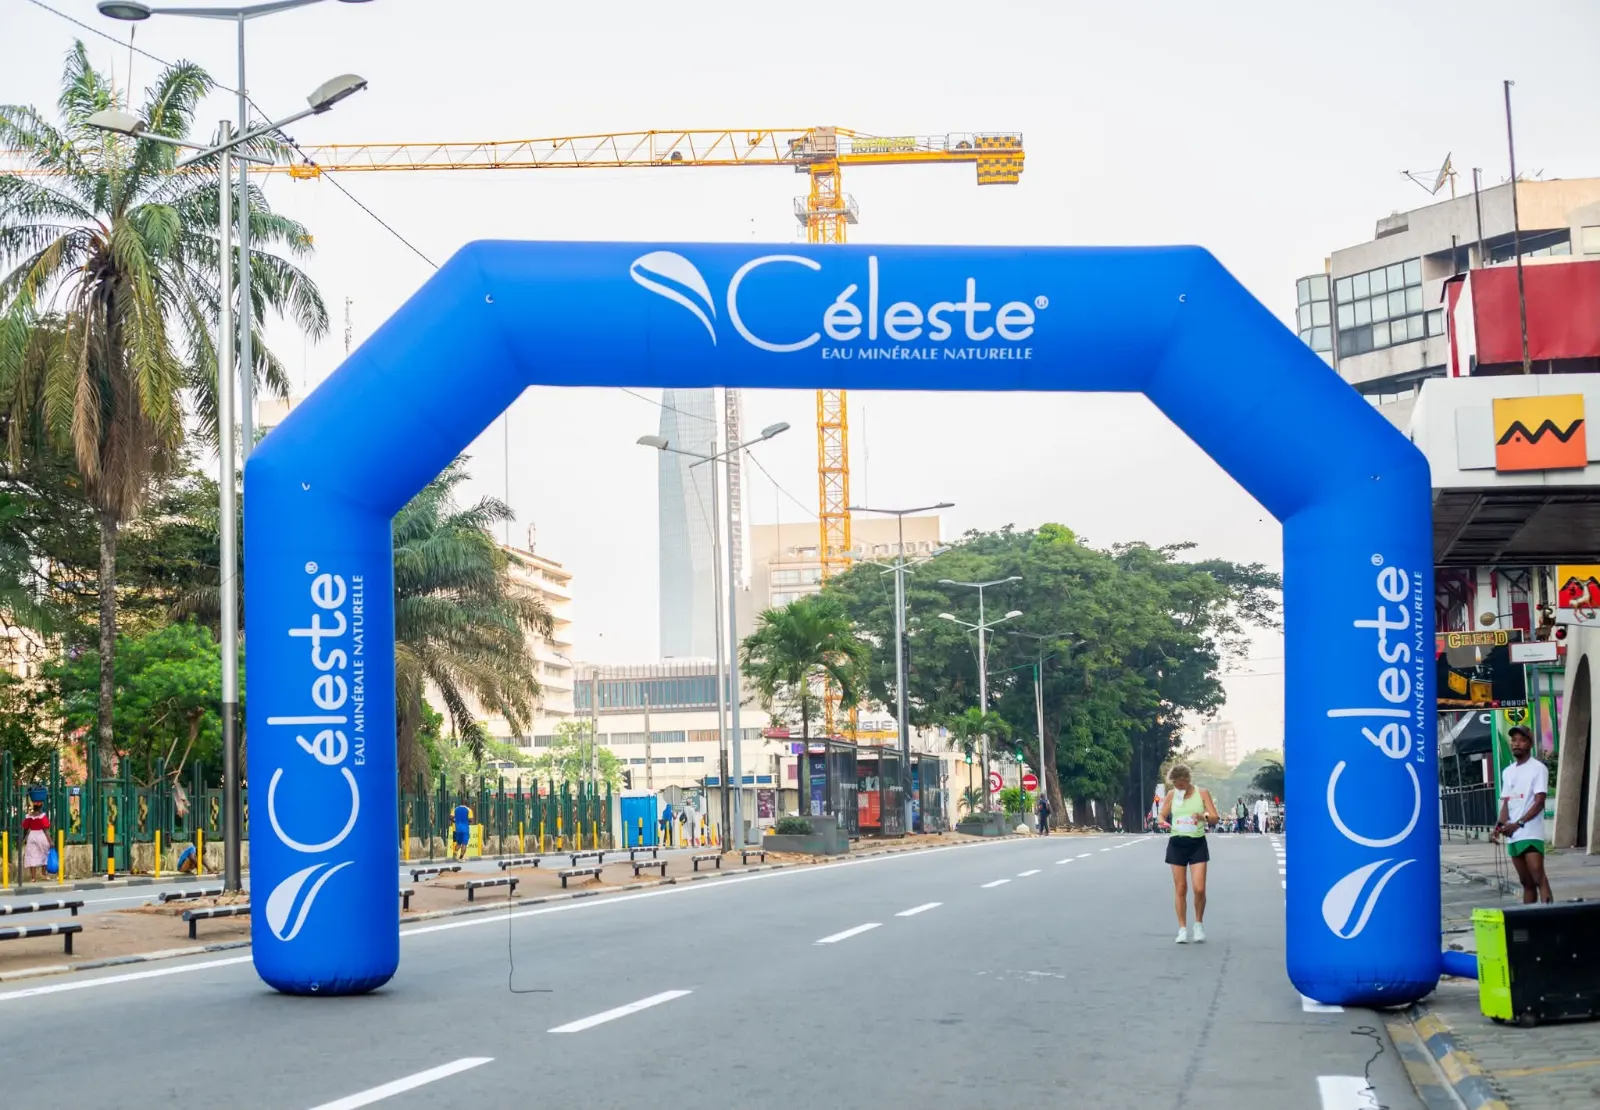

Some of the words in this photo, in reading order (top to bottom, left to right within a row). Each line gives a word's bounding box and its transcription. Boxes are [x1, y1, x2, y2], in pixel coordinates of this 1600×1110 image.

[822, 348, 853, 360] EAU
[858, 345, 938, 360] MINÉRALE
[943, 347, 1033, 360] NATURELLE
[352, 574, 364, 656] NATURELLE
[1414, 570, 1424, 652] NATURELLE
[1448, 630, 1508, 649] CREED
[351, 659, 365, 733] MINÉRALE
[1414, 655, 1425, 734] MINÉRALE
[354, 736, 366, 766] EAU
[1416, 735, 1426, 764] EAU
